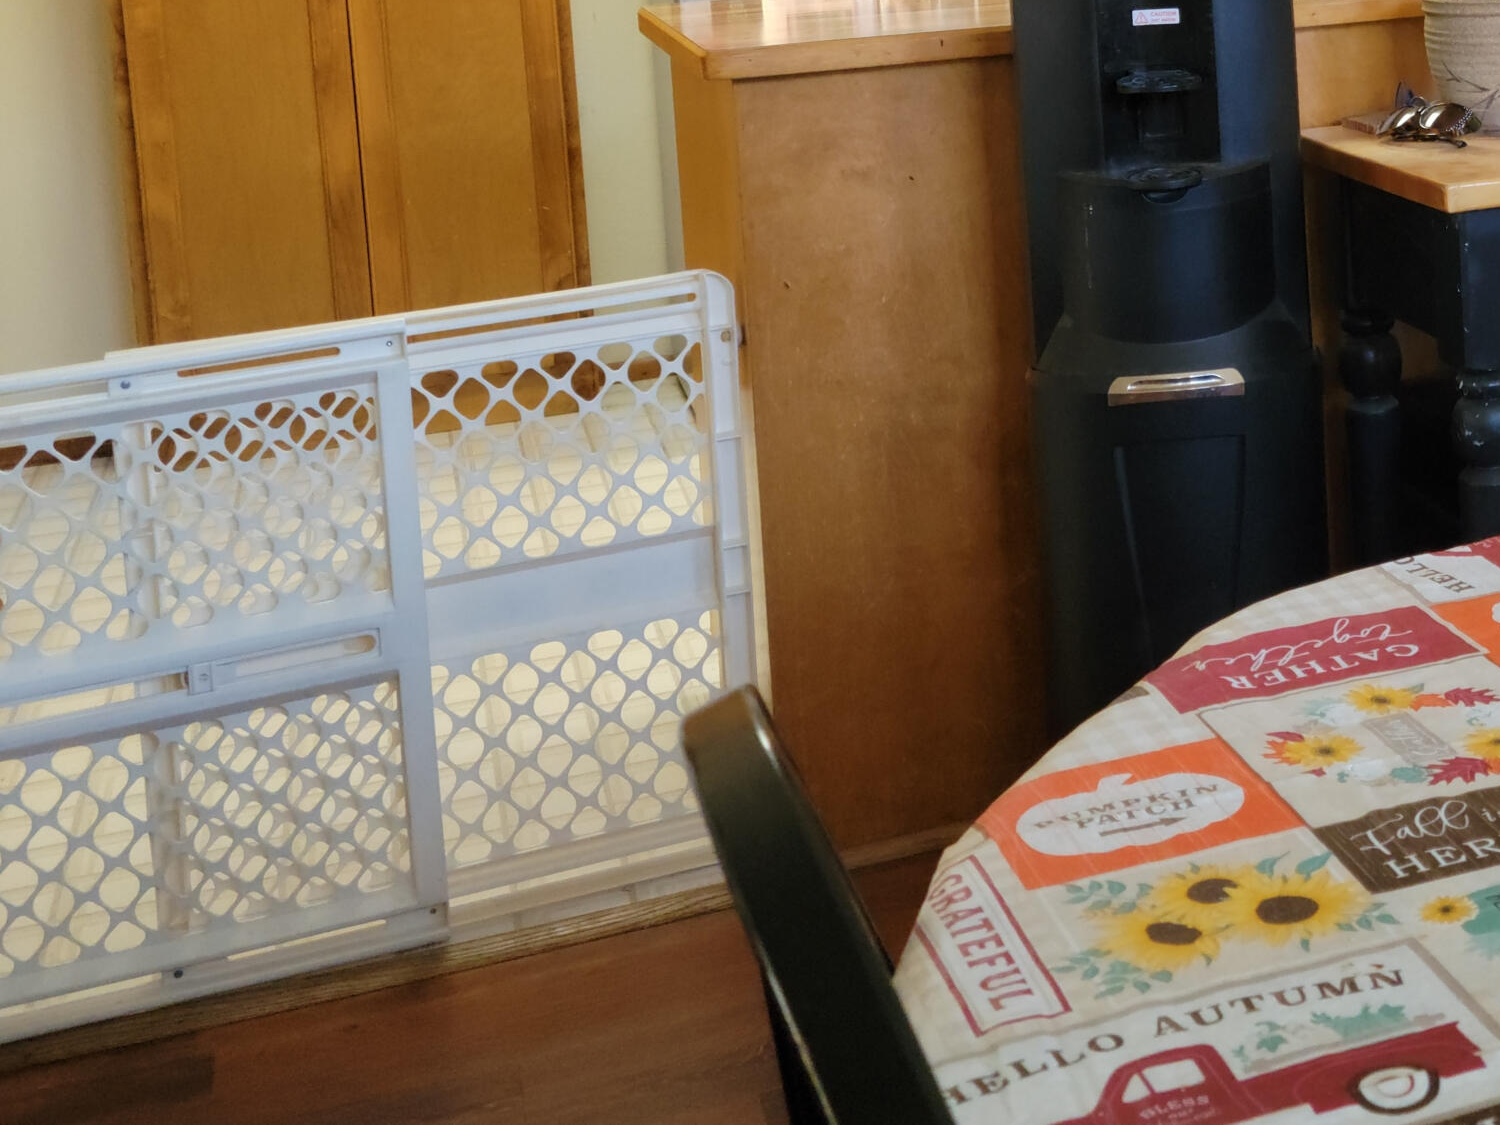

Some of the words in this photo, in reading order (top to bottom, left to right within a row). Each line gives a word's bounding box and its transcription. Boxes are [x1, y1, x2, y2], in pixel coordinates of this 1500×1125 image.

[1221, 644, 1420, 690] GATHER
[1034, 784, 1219, 829] PUMPKIN
[1076, 797, 1195, 829] PATCH
[1350, 799, 1470, 856] Fall
[928, 874, 1034, 1011] GRATEFUL
[1153, 969, 1406, 1038] AUTUMN
[1139, 1094, 1211, 1120] BLESS
